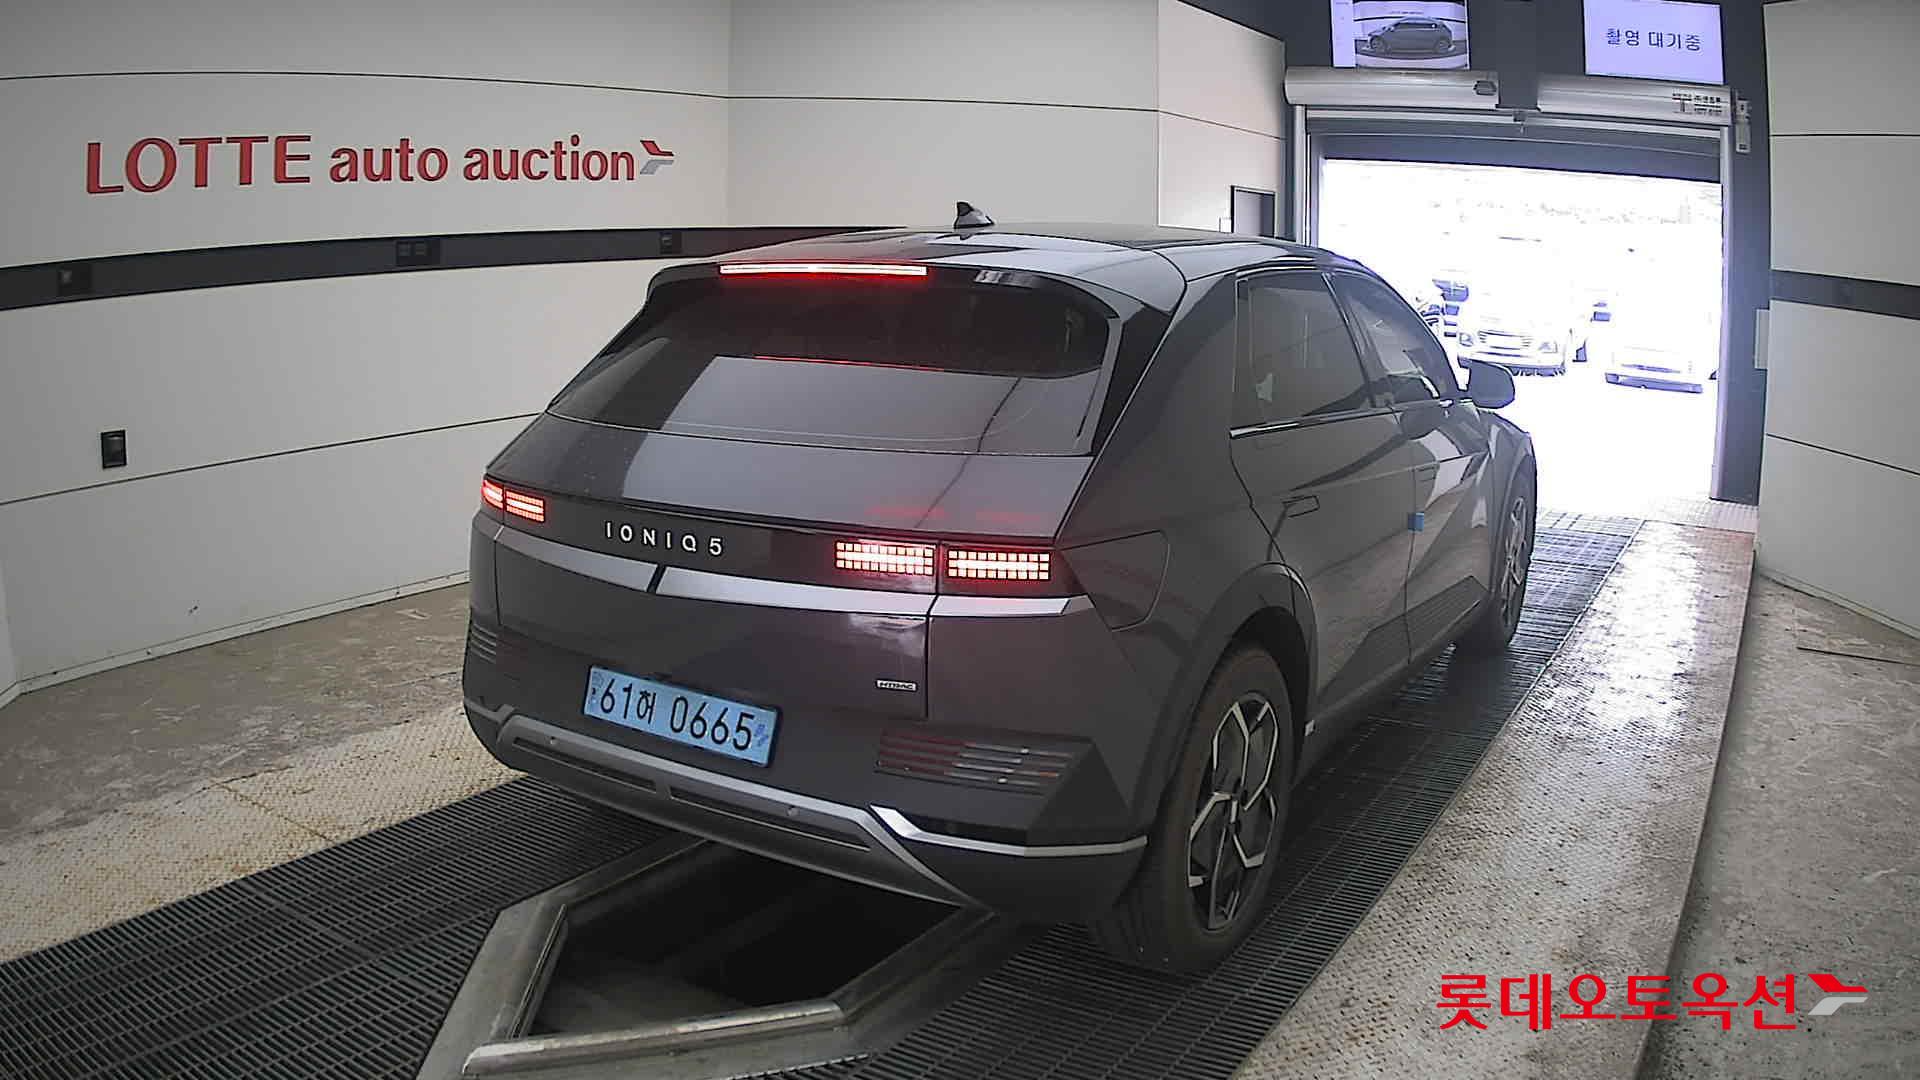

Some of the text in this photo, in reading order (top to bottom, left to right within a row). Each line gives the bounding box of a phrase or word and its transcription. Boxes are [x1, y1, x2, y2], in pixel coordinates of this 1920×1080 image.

[1607, 28, 1701, 52] 촬영 대기중
[86, 135, 636, 194] LOTTE auto auction
[606, 522, 722, 556] IONIQ 5
[600, 678, 756, 751] 61허 0665
